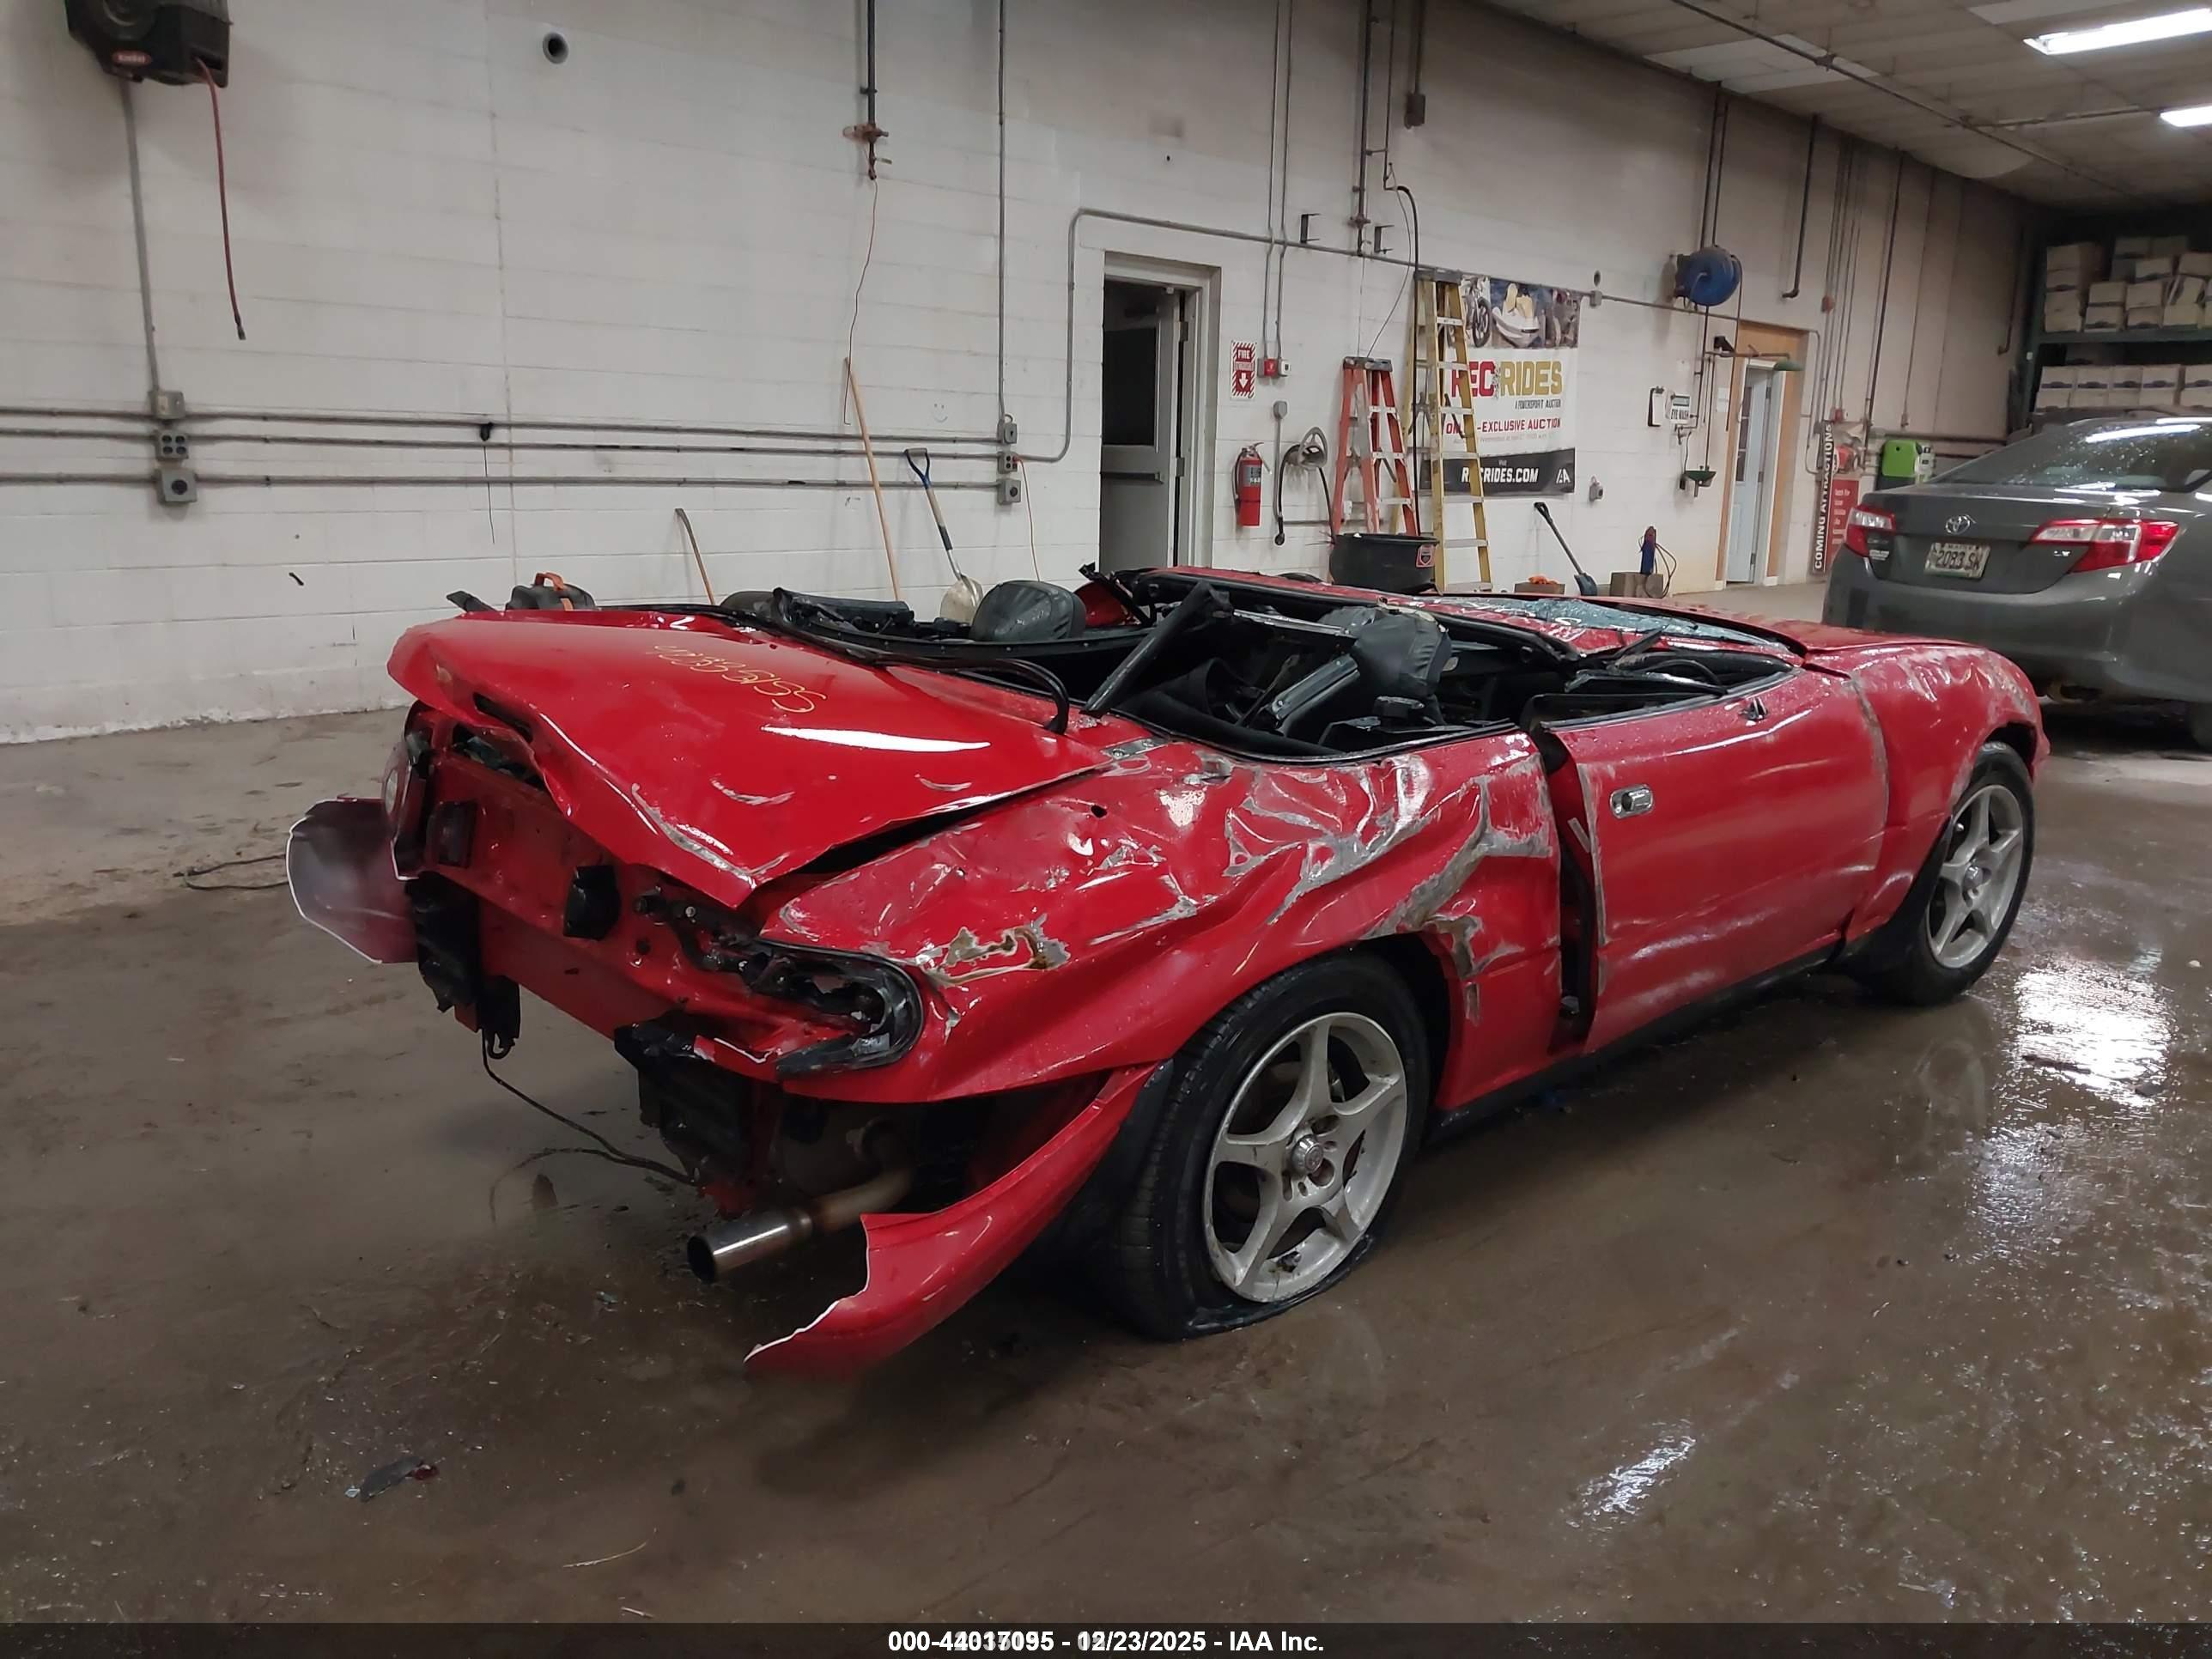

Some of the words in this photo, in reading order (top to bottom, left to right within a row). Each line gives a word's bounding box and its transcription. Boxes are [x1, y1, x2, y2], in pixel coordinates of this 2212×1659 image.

[1237, 349, 1250, 359] FIRE
[1500, 361, 1563, 397] RIDES
[1446, 420, 1525, 434] ON-EXCLUSIVE
[1528, 417, 1561, 430] AUCTION
[1462, 467, 1539, 483] RRIDES.COM
[1814, 516, 1826, 569] COMING
[1936, 550, 1966, 569] 2083
